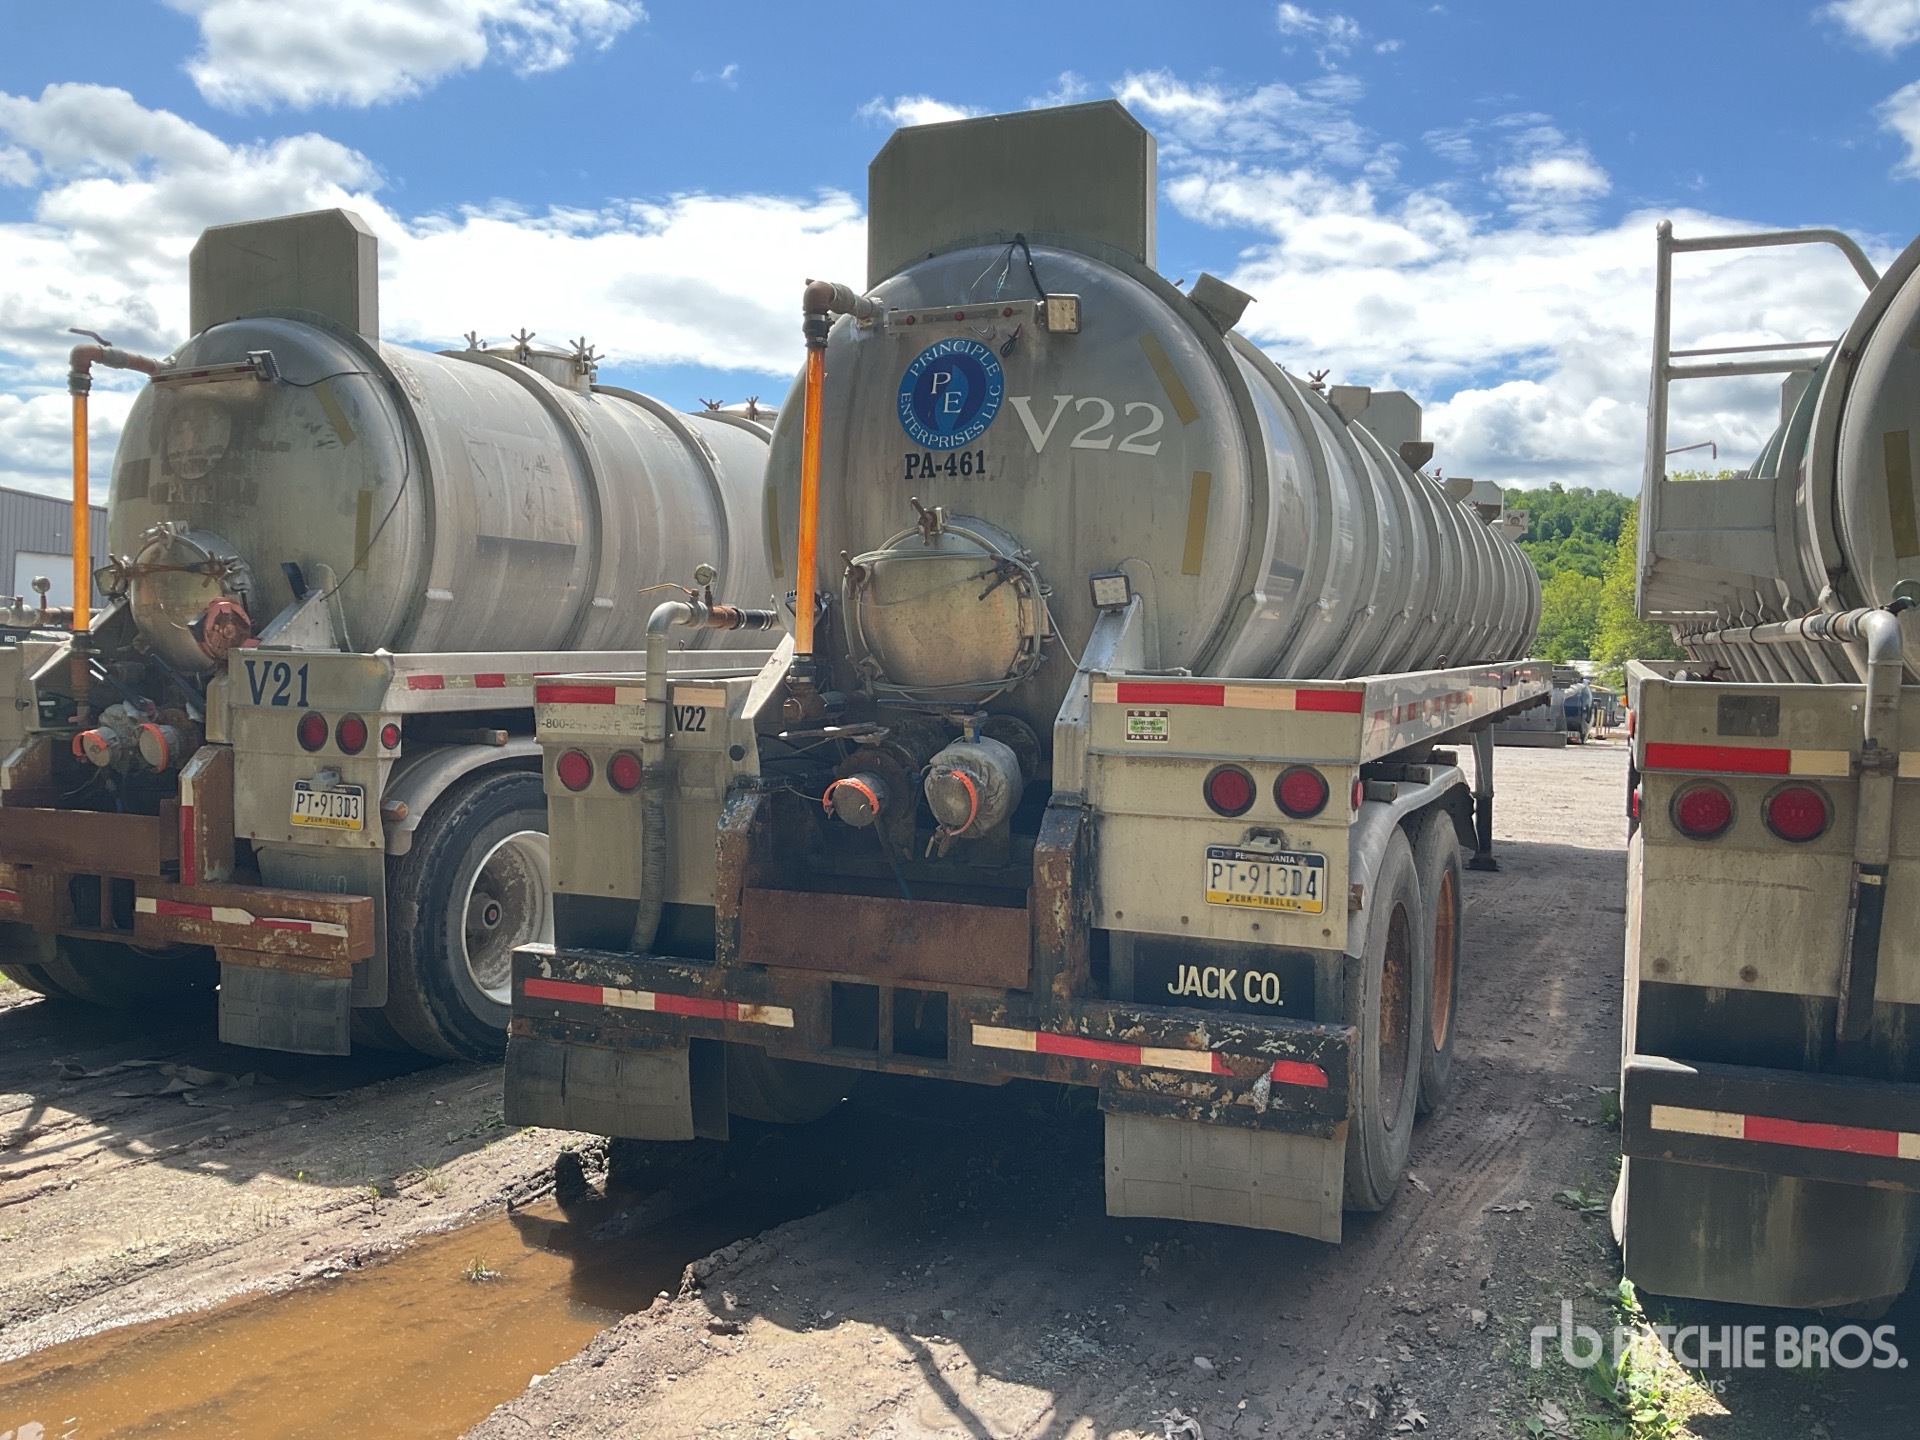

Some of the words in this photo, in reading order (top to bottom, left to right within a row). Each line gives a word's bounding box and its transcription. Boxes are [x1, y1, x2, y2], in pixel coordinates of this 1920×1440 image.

[909, 340, 1000, 377] PRINCIPLE
[901, 392, 985, 448] ENTERPRISES
[982, 384, 1001, 420] LLC
[1008, 394, 1165, 456] V22
[904, 449, 986, 480] PA-461
[244, 660, 309, 708] V21
[673, 705, 706, 732] V22
[1167, 964, 1237, 1001] JACK
[1243, 970, 1284, 1006] CO.
